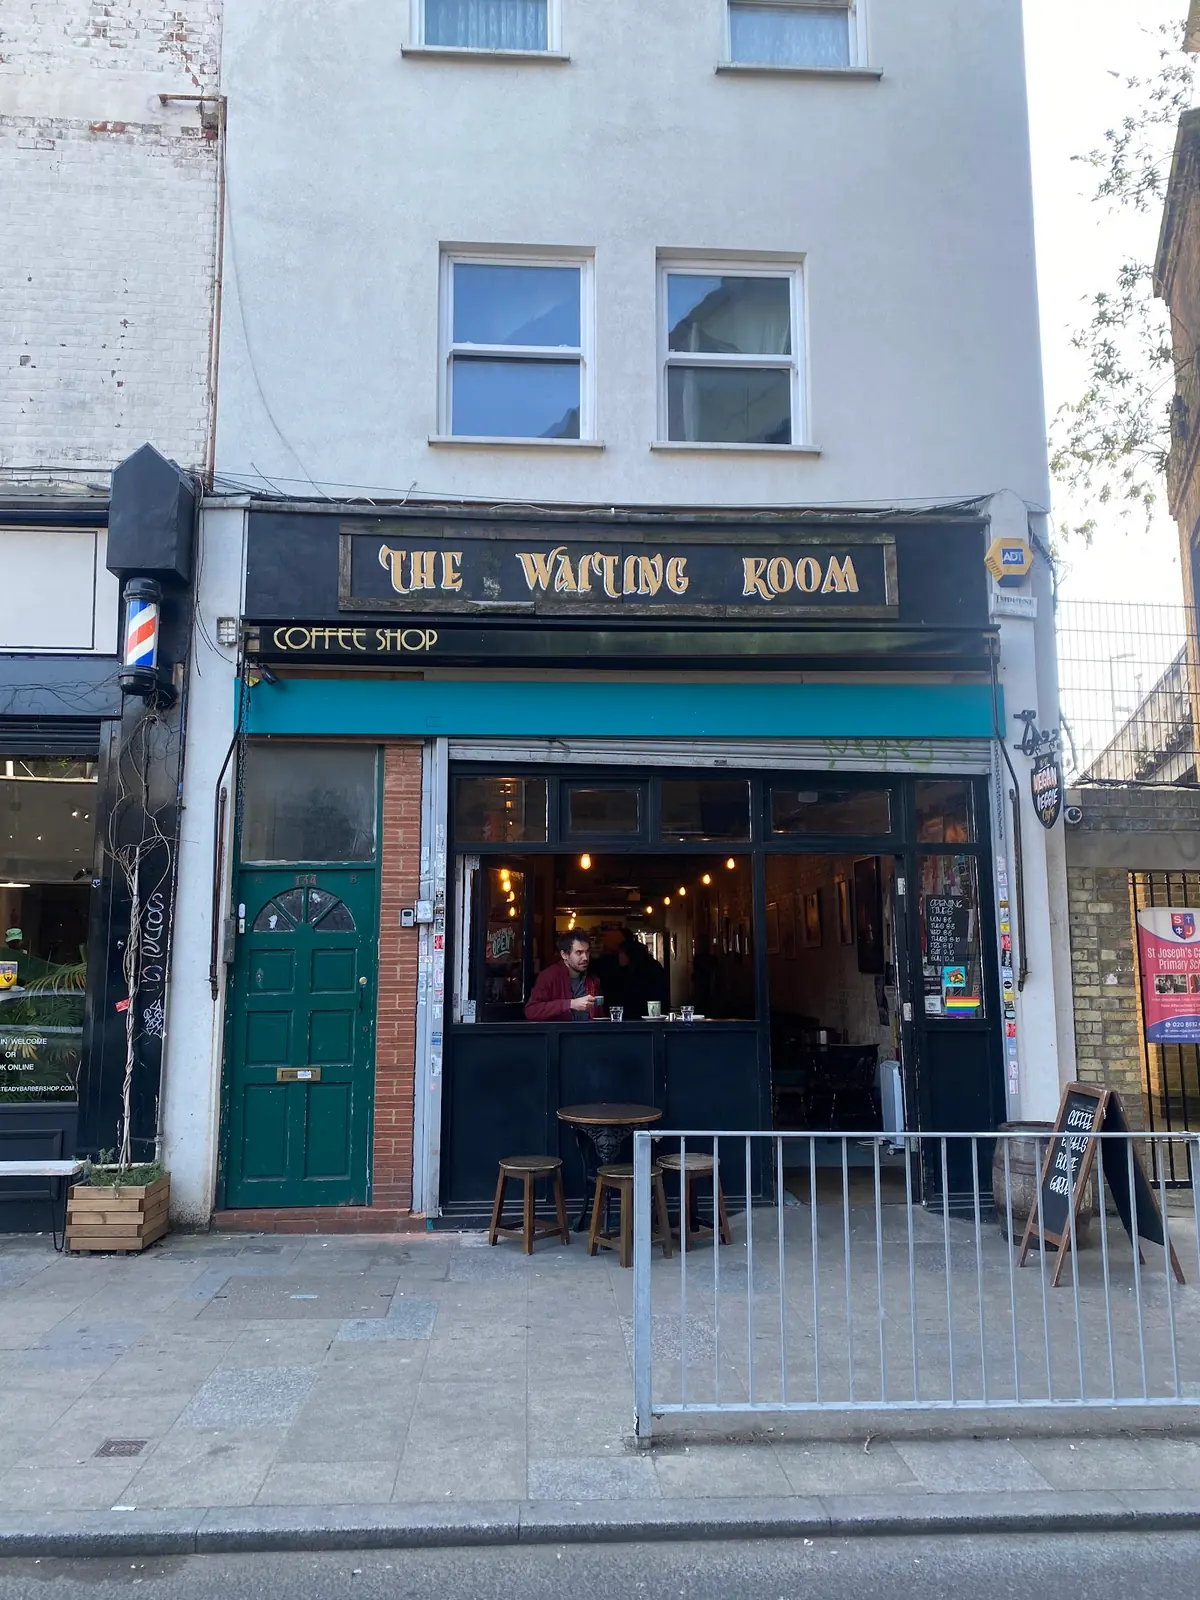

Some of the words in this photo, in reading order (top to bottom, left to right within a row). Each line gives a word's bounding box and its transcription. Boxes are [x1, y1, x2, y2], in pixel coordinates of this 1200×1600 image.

[1002, 551, 1024, 562] ADT
[379, 544, 463, 593] THE
[515, 546, 690, 598] WAITING
[741, 555, 860, 600] ROOM
[273, 626, 367, 651] COFFEE
[375, 628, 438, 651] SHOP
[1033, 766, 1058, 795] VEGAN
[1147, 947, 1156, 959] St
[1157, 947, 1193, 959] Joseph's
[1158, 959, 1189, 971] Primary
[7, 1063, 35, 1071] ONLINE
